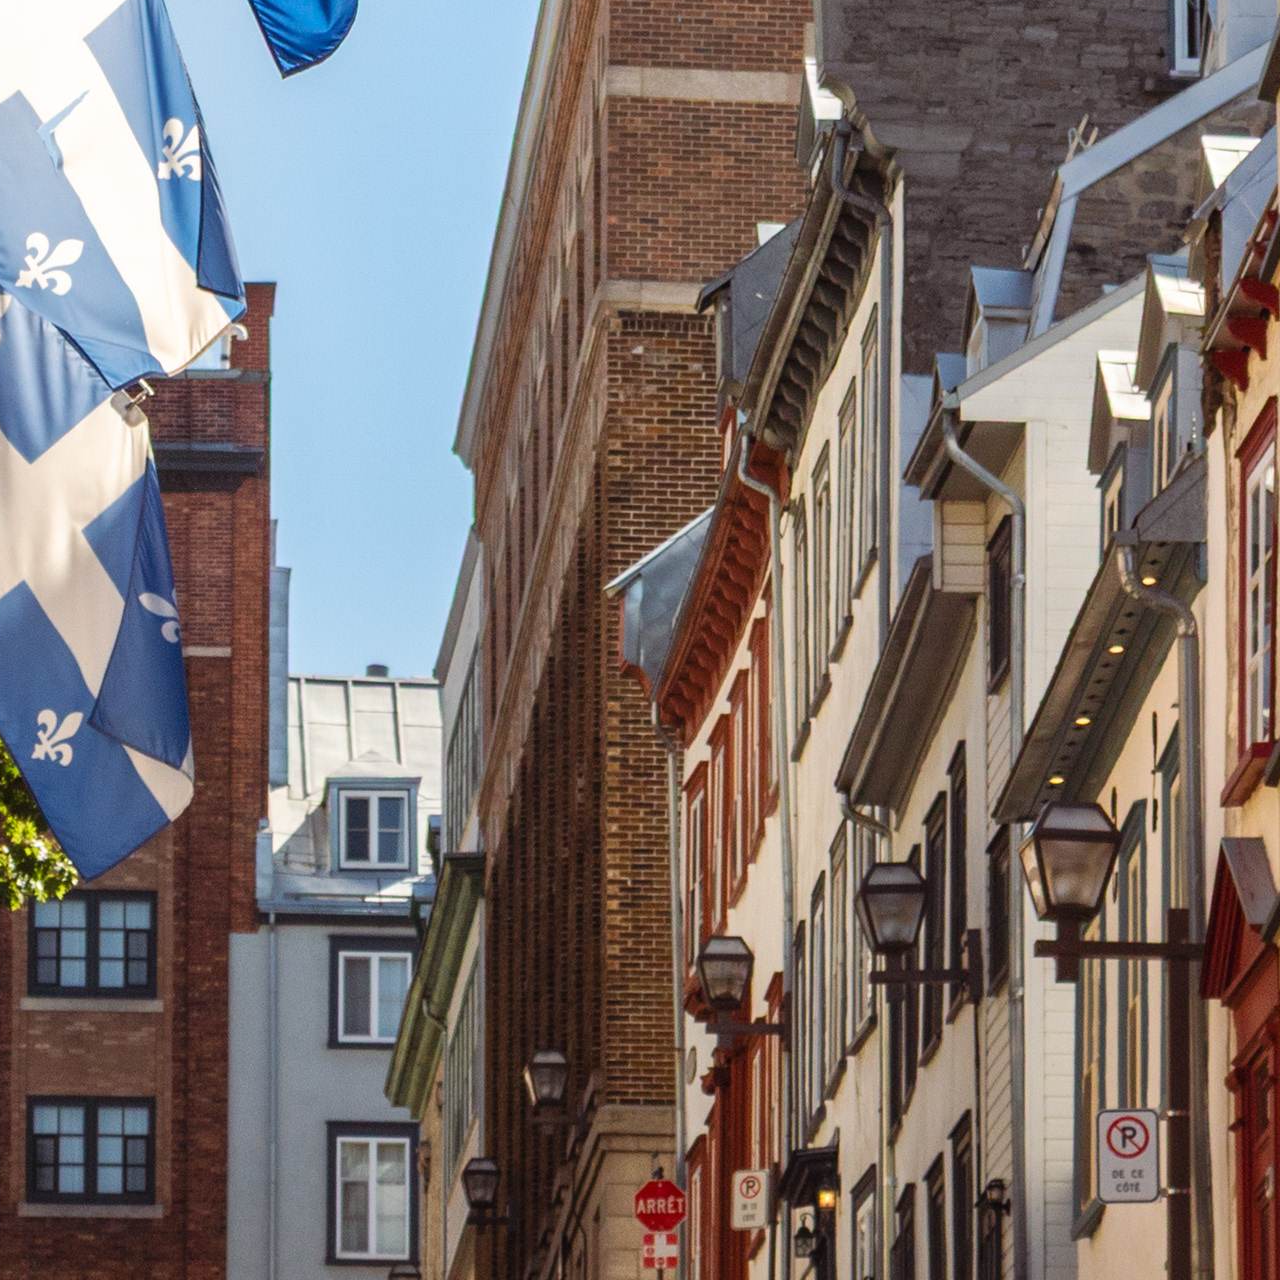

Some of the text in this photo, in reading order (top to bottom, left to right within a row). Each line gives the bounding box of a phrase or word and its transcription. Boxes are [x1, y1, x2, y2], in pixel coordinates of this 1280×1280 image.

[1112, 1169, 1144, 1179] DE CE
[637, 1195, 684, 1214] ARRÊT
